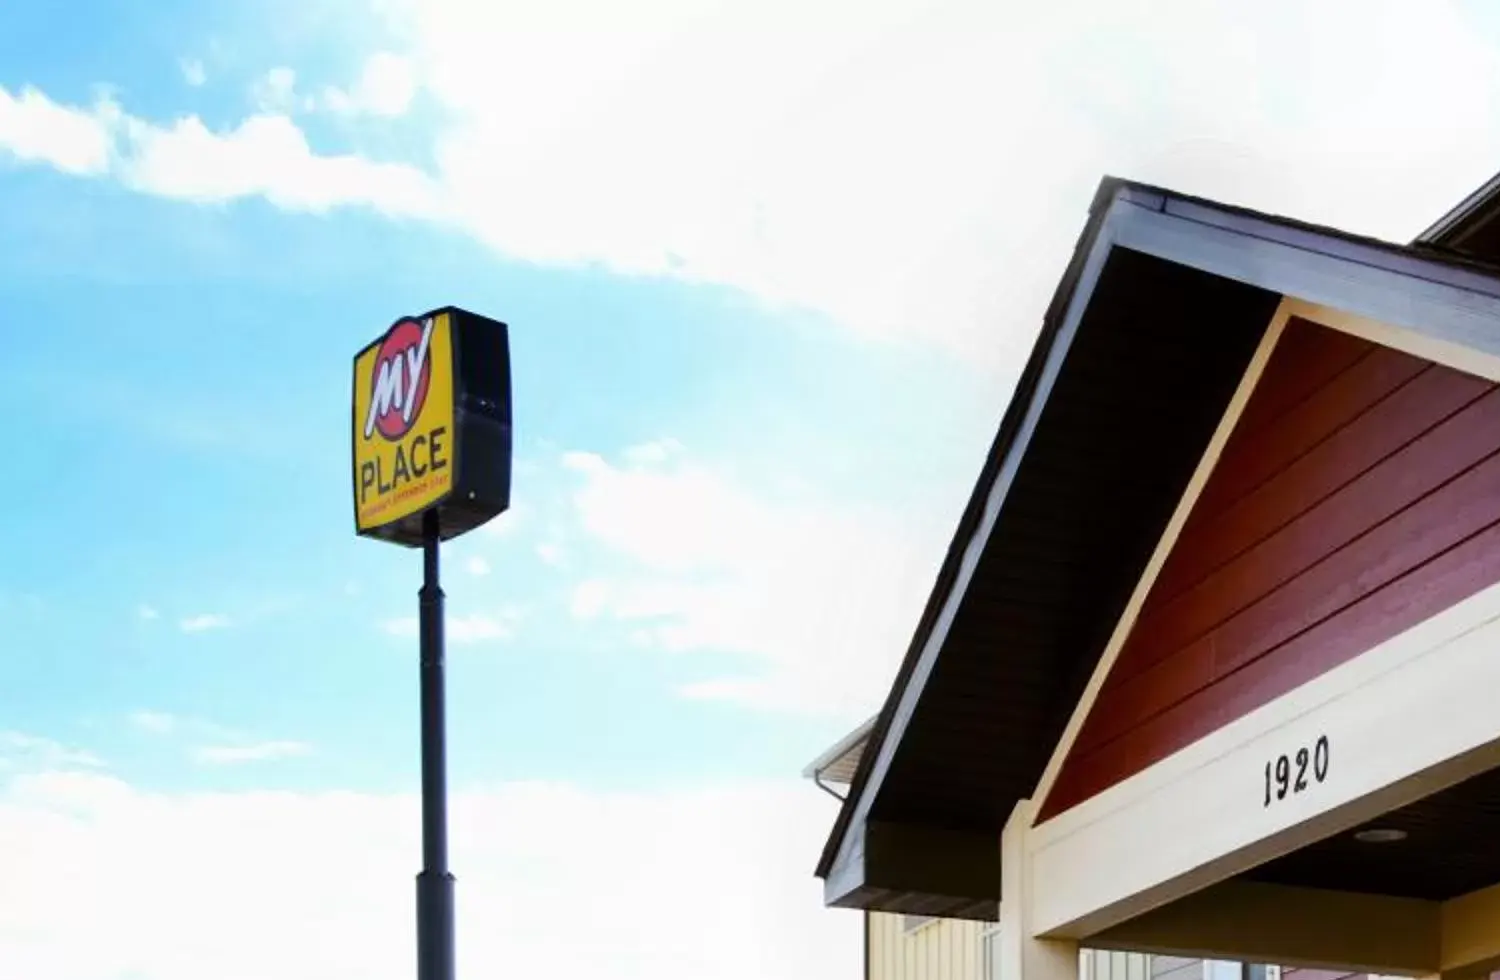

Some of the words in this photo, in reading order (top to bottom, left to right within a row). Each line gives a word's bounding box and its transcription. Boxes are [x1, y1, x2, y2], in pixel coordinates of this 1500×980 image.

[364, 316, 433, 440] MY
[361, 427, 447, 504] PLACE
[1264, 735, 1329, 808] 1920
